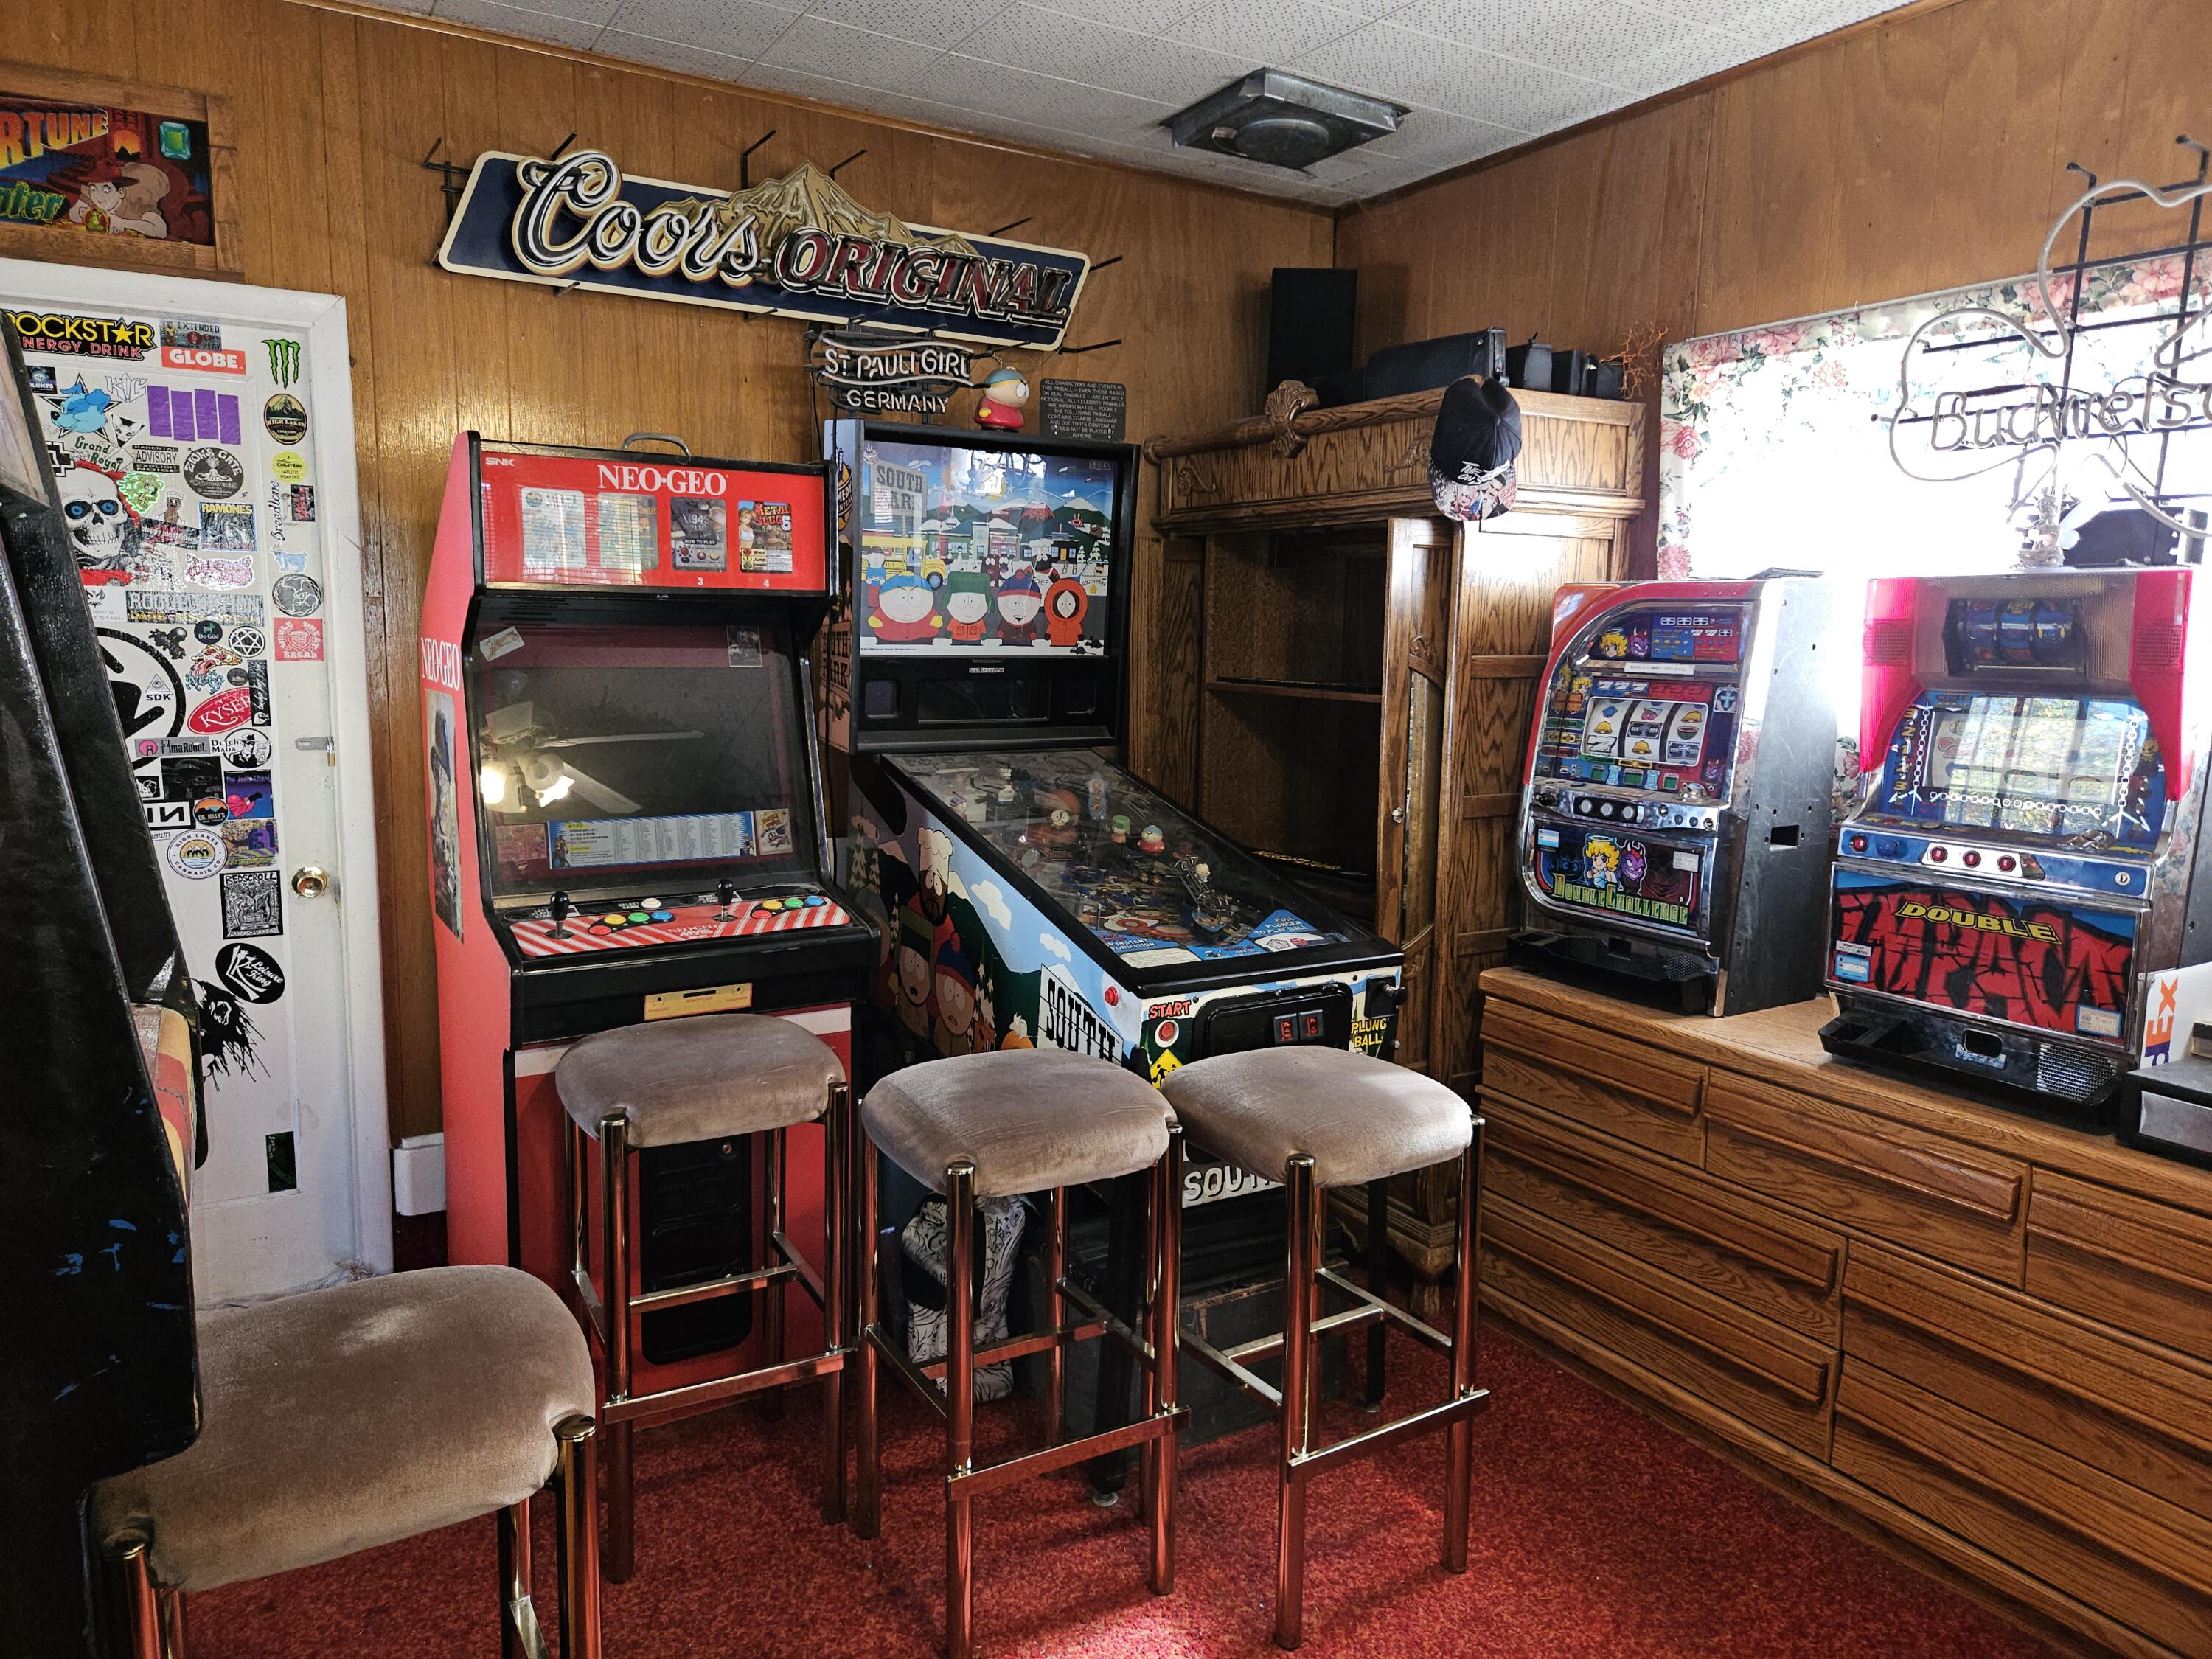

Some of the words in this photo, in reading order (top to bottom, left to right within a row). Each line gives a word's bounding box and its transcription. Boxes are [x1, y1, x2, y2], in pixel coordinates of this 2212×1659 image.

[516, 149, 771, 286] Coors
[776, 226, 1071, 330] ORIGINAL
[178, 321, 220, 333] EXTENDED
[22, 337, 82, 352] NERGY
[91, 342, 142, 358] DRINK
[202, 341, 220, 350] PLAY
[824, 348, 851, 377] ST
[857, 354, 916, 379] PAULI
[921, 349, 970, 378] GIRL
[846, 389, 949, 414] GERMANY
[74, 436, 111, 453] Grand
[91, 452, 123, 472] Royal
[136, 451, 178, 465] ADVISORY
[218, 451, 243, 476] GATE
[484, 456, 515, 467] SNK
[877, 465, 923, 494] SOUTH
[201, 503, 252, 515] RAMONES
[697, 577, 704, 586] 3
[762, 579, 771, 588] 4
[283, 650, 318, 658] BREAD
[146, 692, 171, 701] SDK
[207, 812, 226, 821] JOLLY'S
[175, 834, 192, 848] HIGH
[195, 833, 219, 846] LAKES
[175, 861, 212, 875] CANNABIS
[226, 872, 277, 885] REDSCROLL
[1893, 901, 2062, 945] DOUBLE
[246, 969, 272, 987] King
[251, 961, 284, 985] Leisure
[1148, 1000, 1192, 1019] START
[1350, 1017, 1390, 1034] PLUNG
[1354, 1032, 1383, 1048] BALL
[1184, 1165, 1270, 1201] SOU
